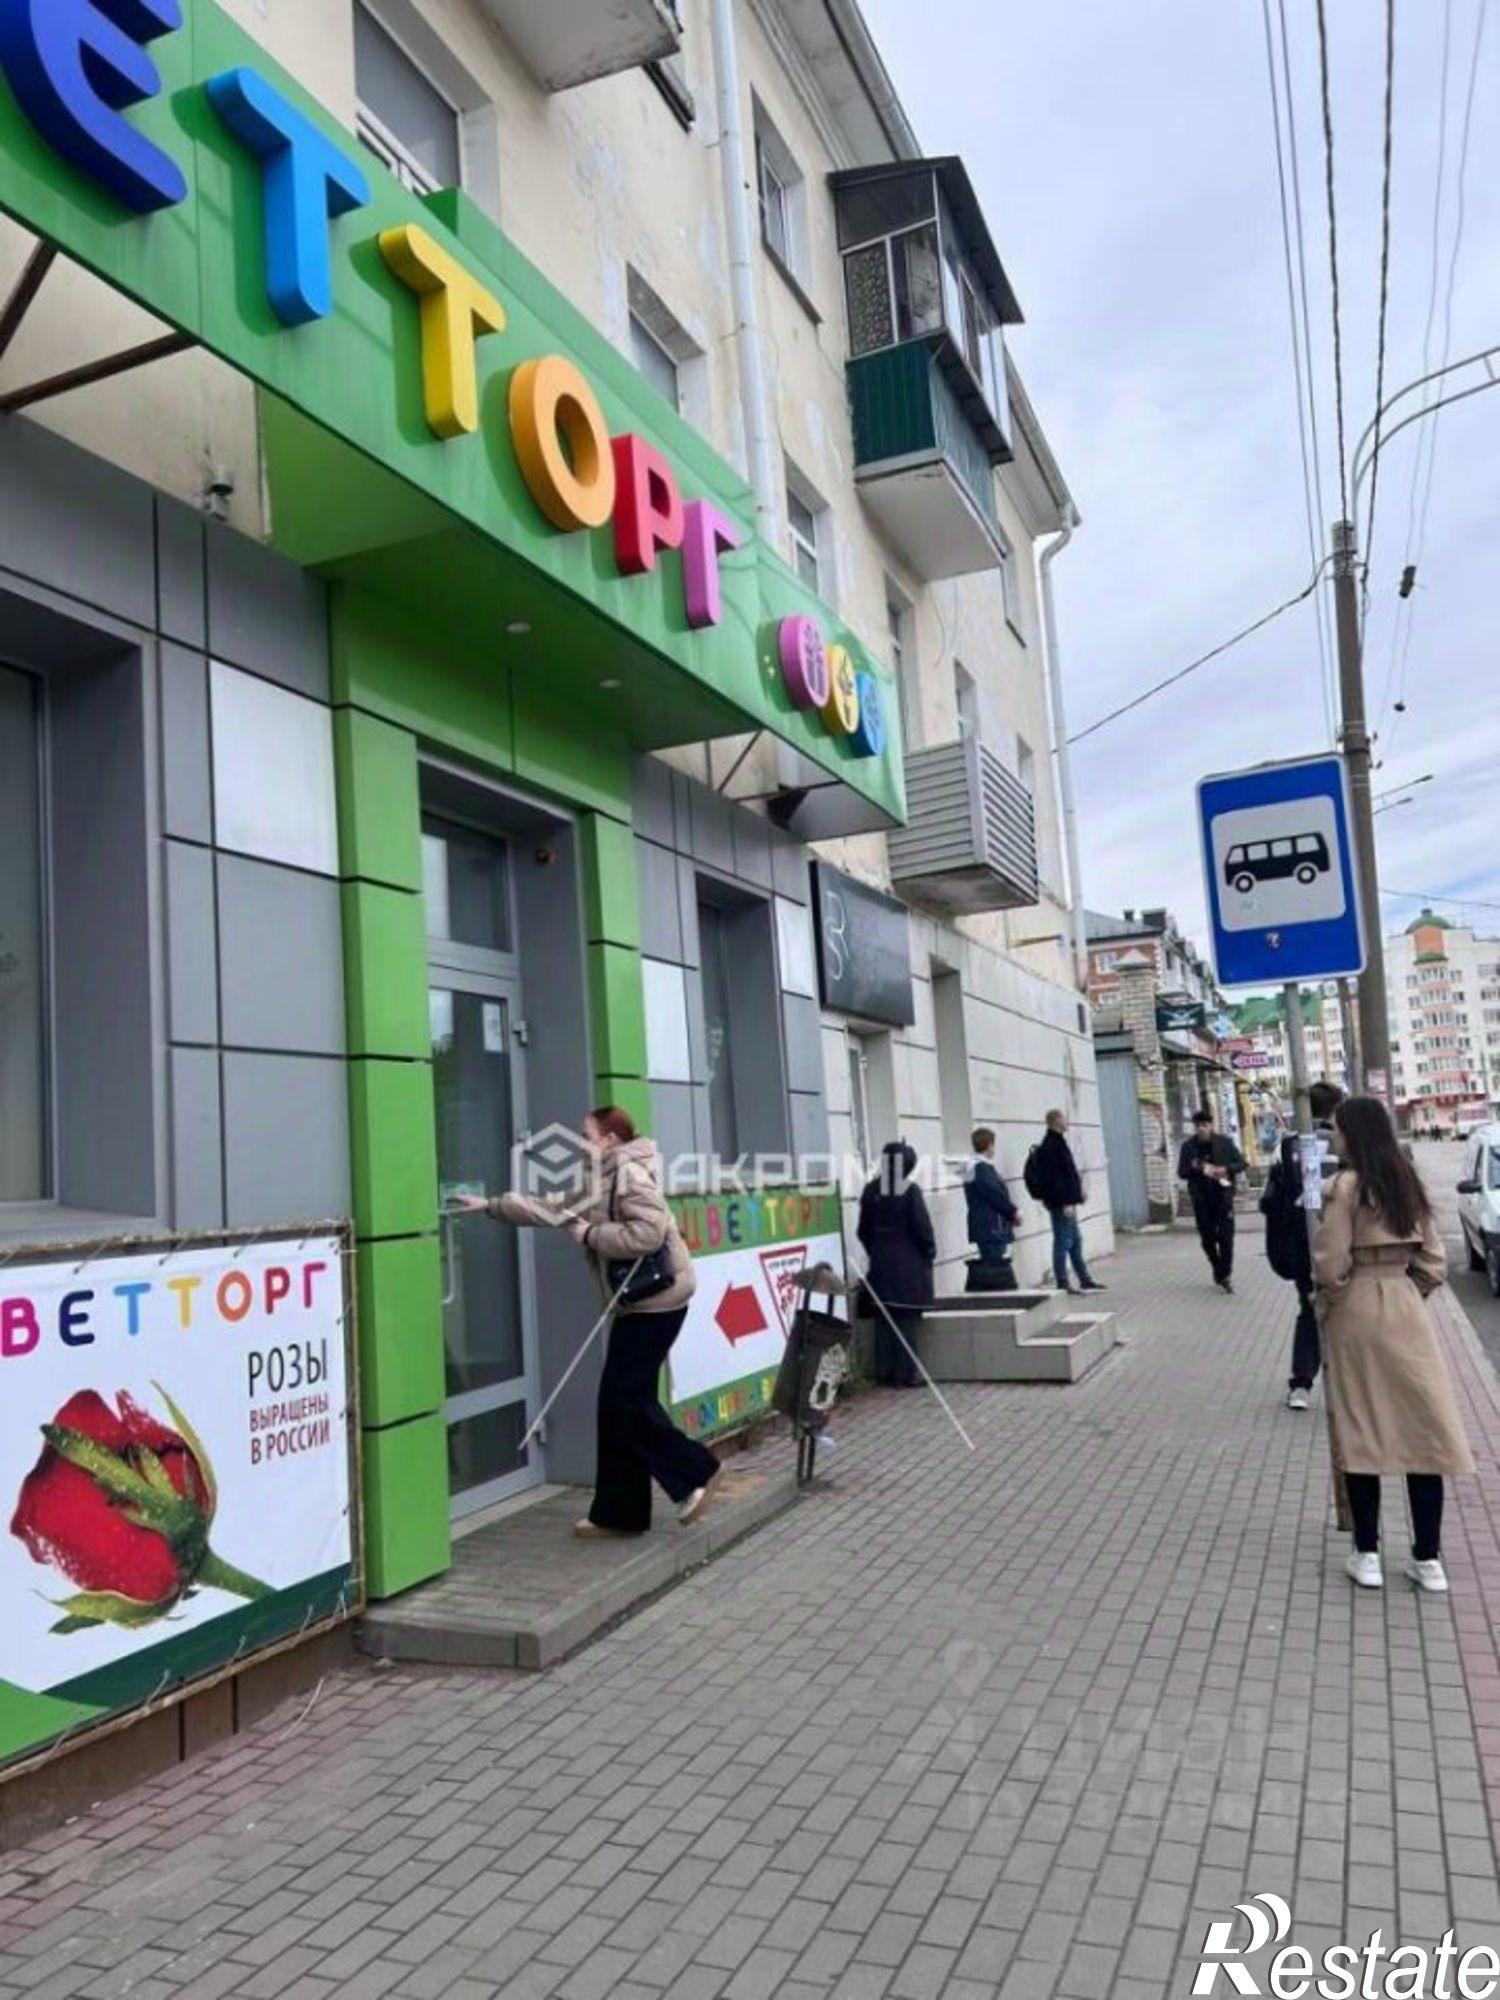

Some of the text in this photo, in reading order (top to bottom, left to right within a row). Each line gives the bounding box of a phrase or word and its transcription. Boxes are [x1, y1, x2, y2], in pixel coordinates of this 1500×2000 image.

[248, 1338, 328, 1397] РОЗЫ
[250, 1392, 330, 1432] ВЫРАЩЕНЫ
[251, 1419, 331, 1465] В РОССИИ
